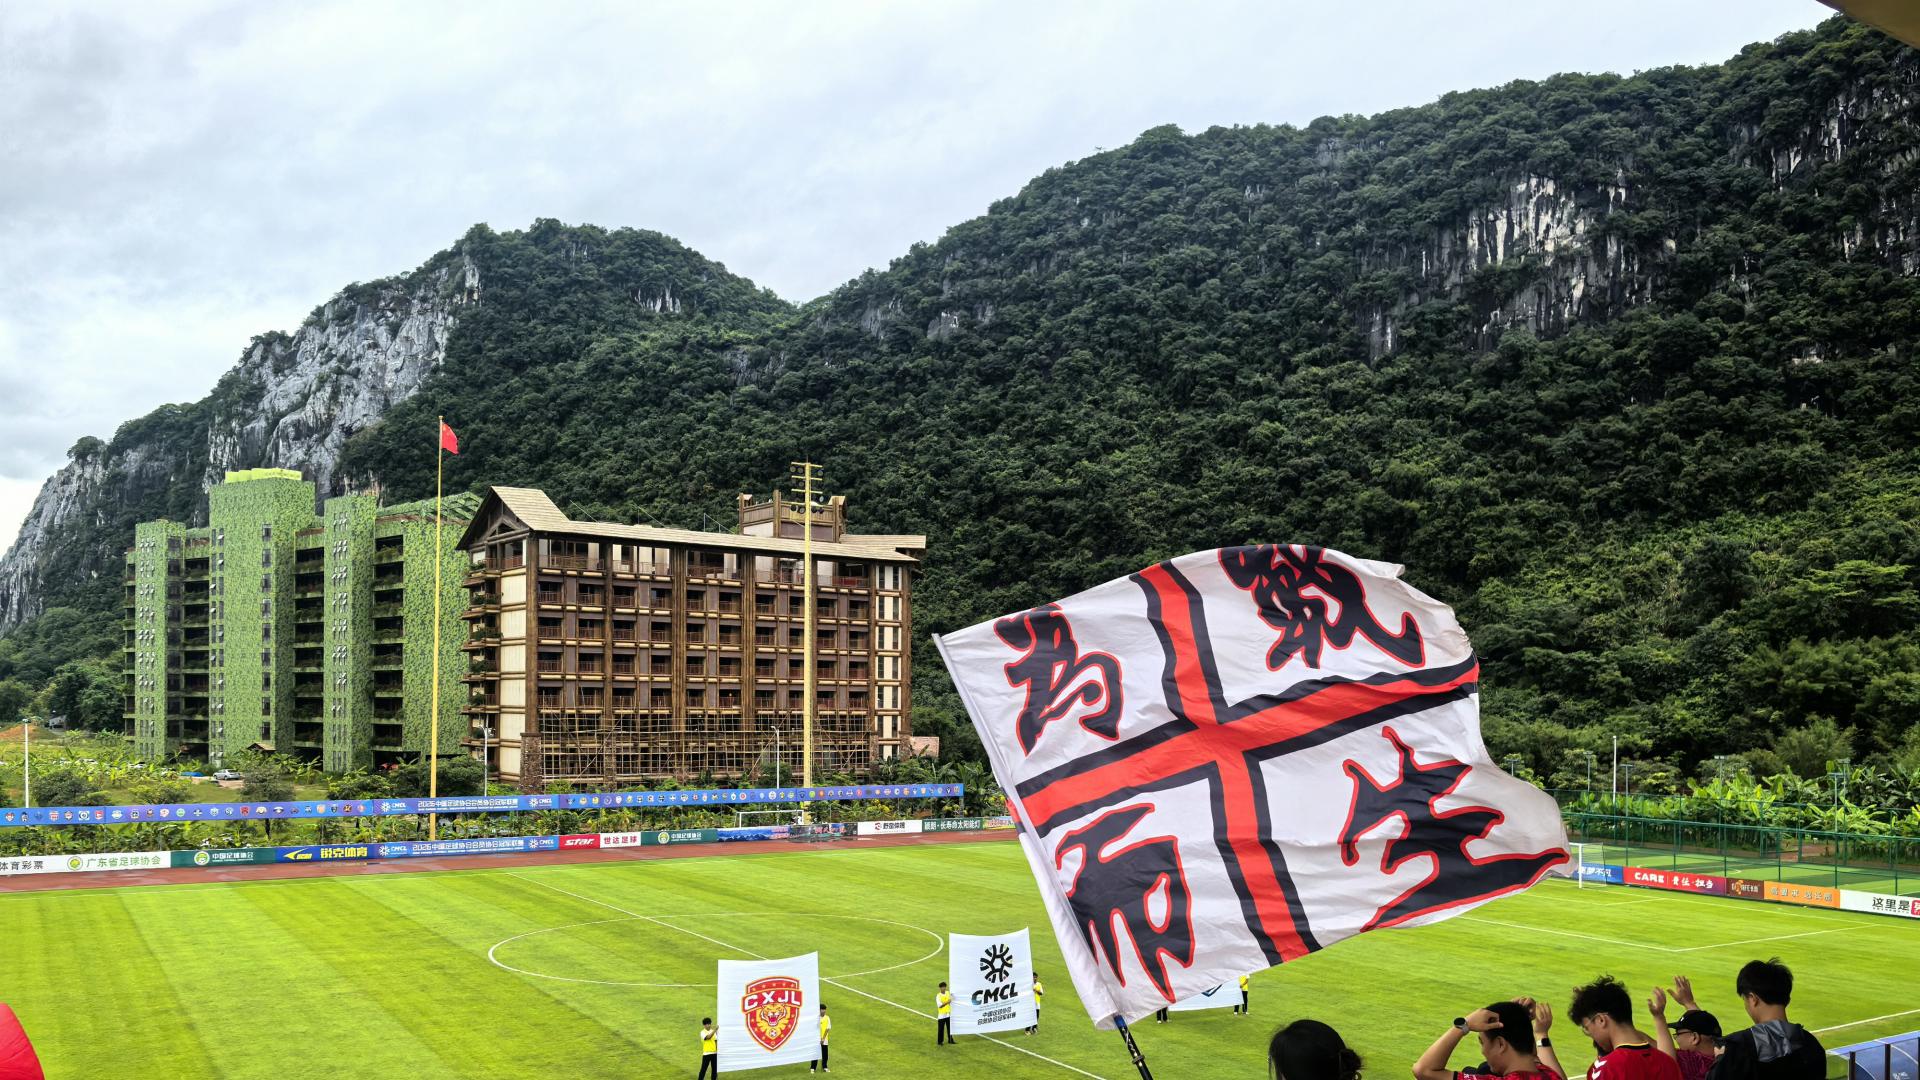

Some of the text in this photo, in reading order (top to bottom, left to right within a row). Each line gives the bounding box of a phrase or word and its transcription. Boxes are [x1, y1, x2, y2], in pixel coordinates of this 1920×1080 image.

[604, 836, 638, 845] 世达足球
[320, 847, 367, 858] 锐克体育
[86, 856, 161, 868] 广东省足球协会
[1634, 872, 1665, 883] CARE
[1872, 896, 1910, 911] 这里是
[971, 982, 1018, 1005] CMCL
[744, 990, 800, 1010] CXJL
